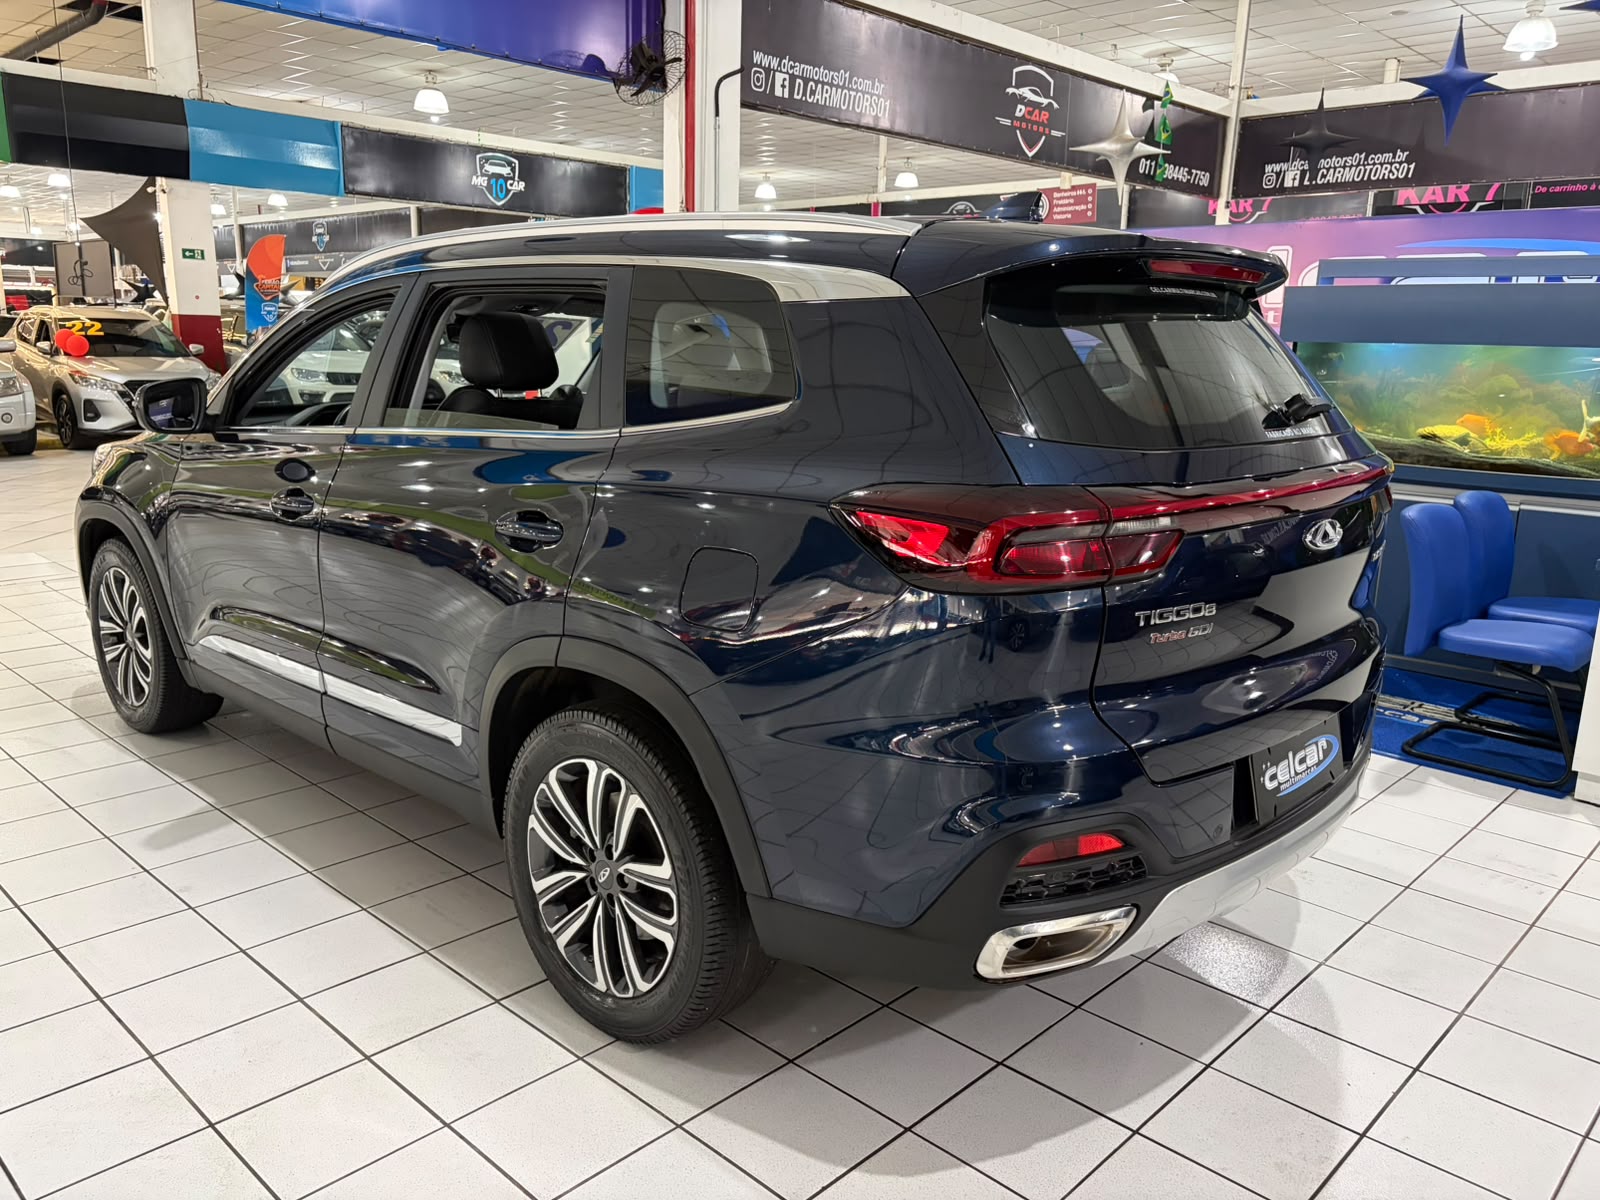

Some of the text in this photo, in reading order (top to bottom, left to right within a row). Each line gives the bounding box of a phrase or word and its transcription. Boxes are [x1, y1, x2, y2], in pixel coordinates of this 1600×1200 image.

[753, 50, 884, 95] www.dcarmotors01.com.br
[794, 79, 890, 119] D.CARMOTORS01
[1014, 104, 1050, 124] DCAR
[1013, 120, 1050, 135] MOTORS
[1138, 158, 1155, 176] 011
[471, 175, 525, 199] MG 10 CAR
[1535, 185, 1548, 194] De
[1549, 183, 1588, 193] carrinho
[1150, 630, 1187, 644] Turbo
[1264, 737, 1328, 791] celcar
[1280, 764, 1318, 792] multimarcas
